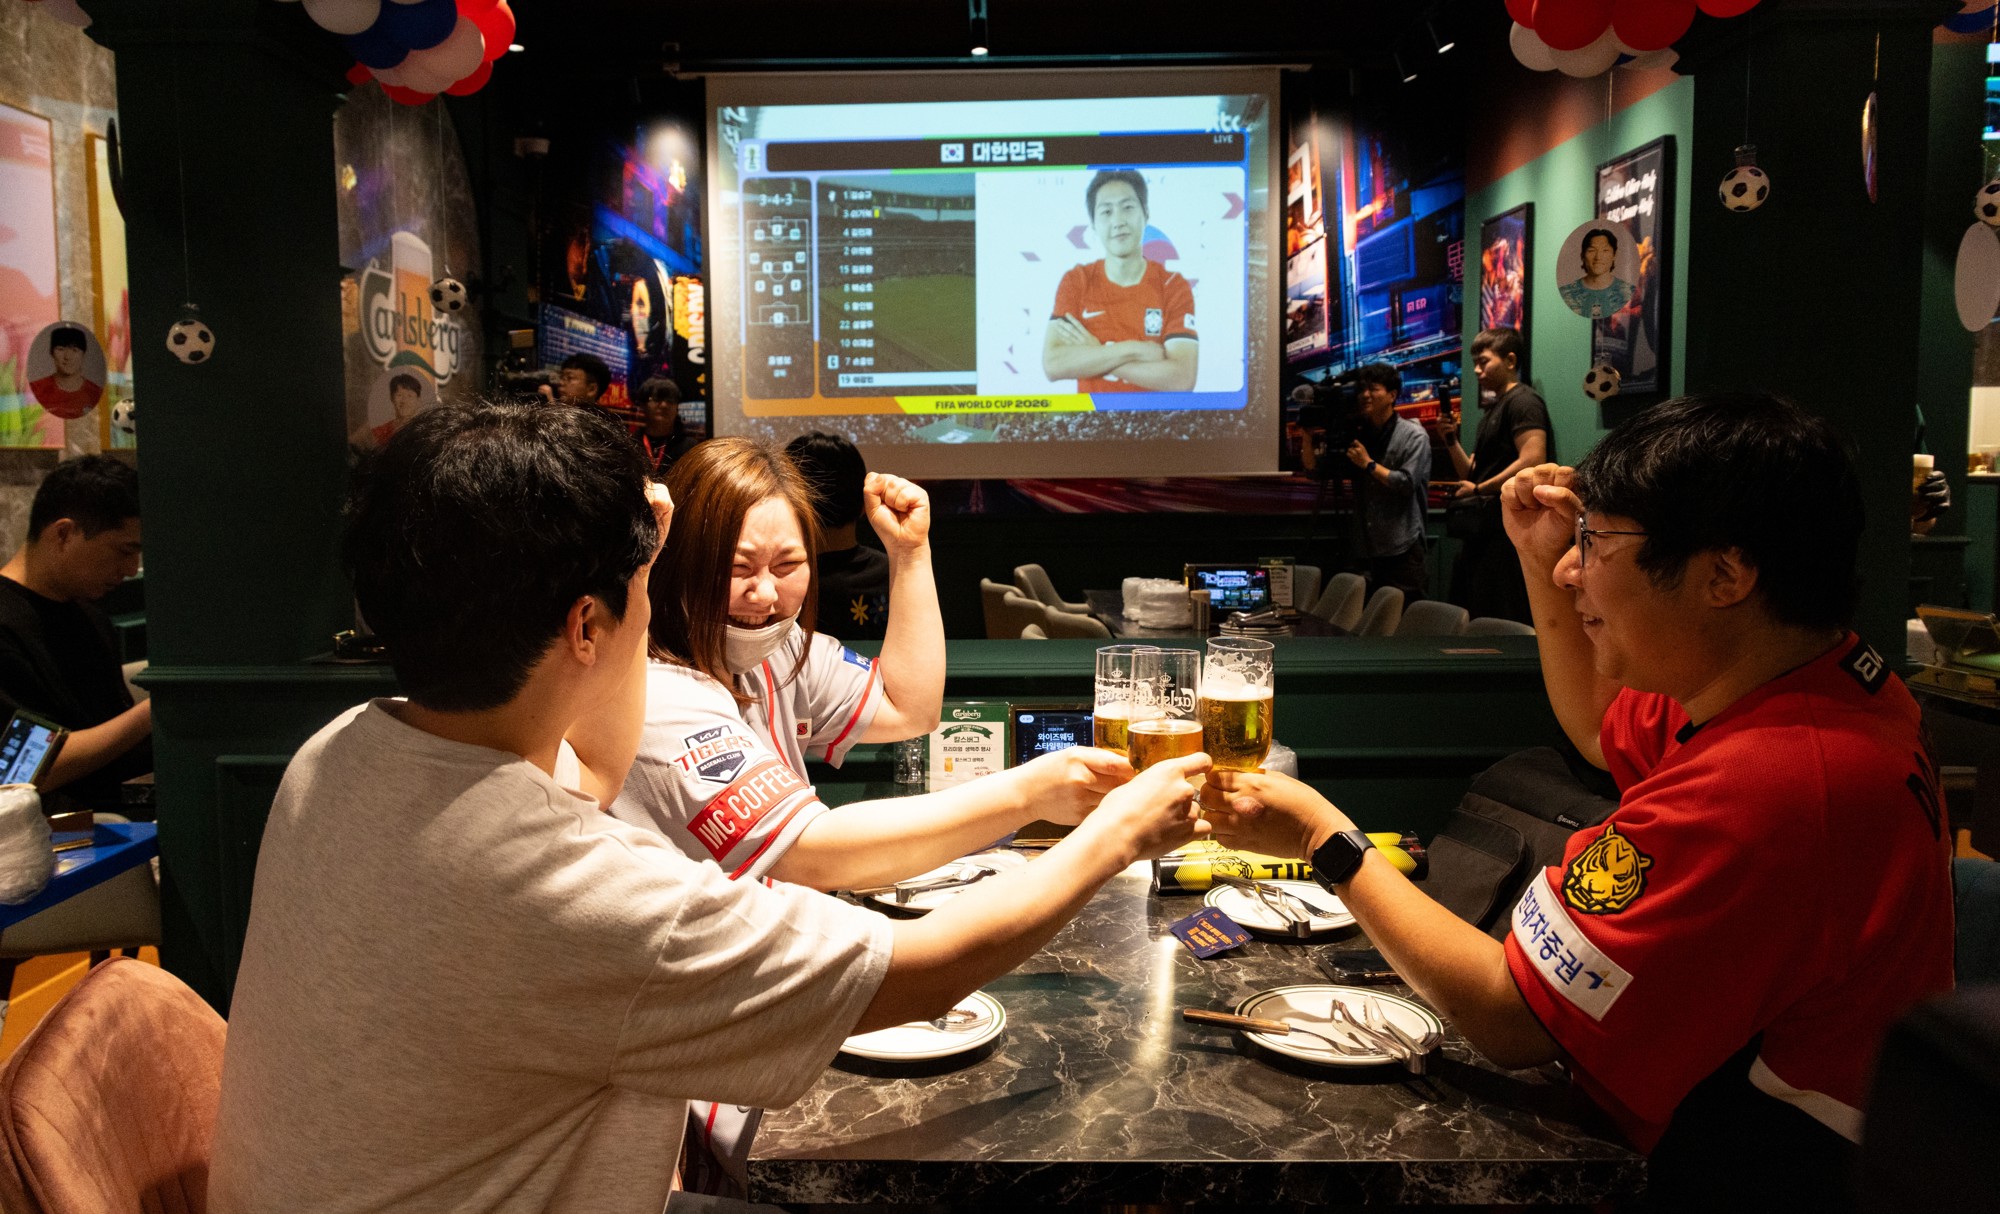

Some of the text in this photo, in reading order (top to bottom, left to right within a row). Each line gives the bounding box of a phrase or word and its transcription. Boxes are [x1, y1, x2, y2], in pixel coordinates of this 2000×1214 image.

[1213, 134, 1234, 144] LIVE
[972, 141, 1045, 162] 대한민국
[759, 193, 793, 206] 3-4-3
[361, 268, 461, 374] Carlsberg
[936, 399, 1049, 409] FIFA WORLD CUP 2026
[952, 709, 981, 720] Carlsberg
[1038, 733, 1074, 741] 와이즈웨딩
[674, 735, 755, 771] TIGERS
[700, 752, 741, 771] BASEBALL CLUB
[728, 765, 799, 820] COFFEE
[1261, 863, 1312, 880] TIG
[1518, 886, 1584, 985] 현대차증권
